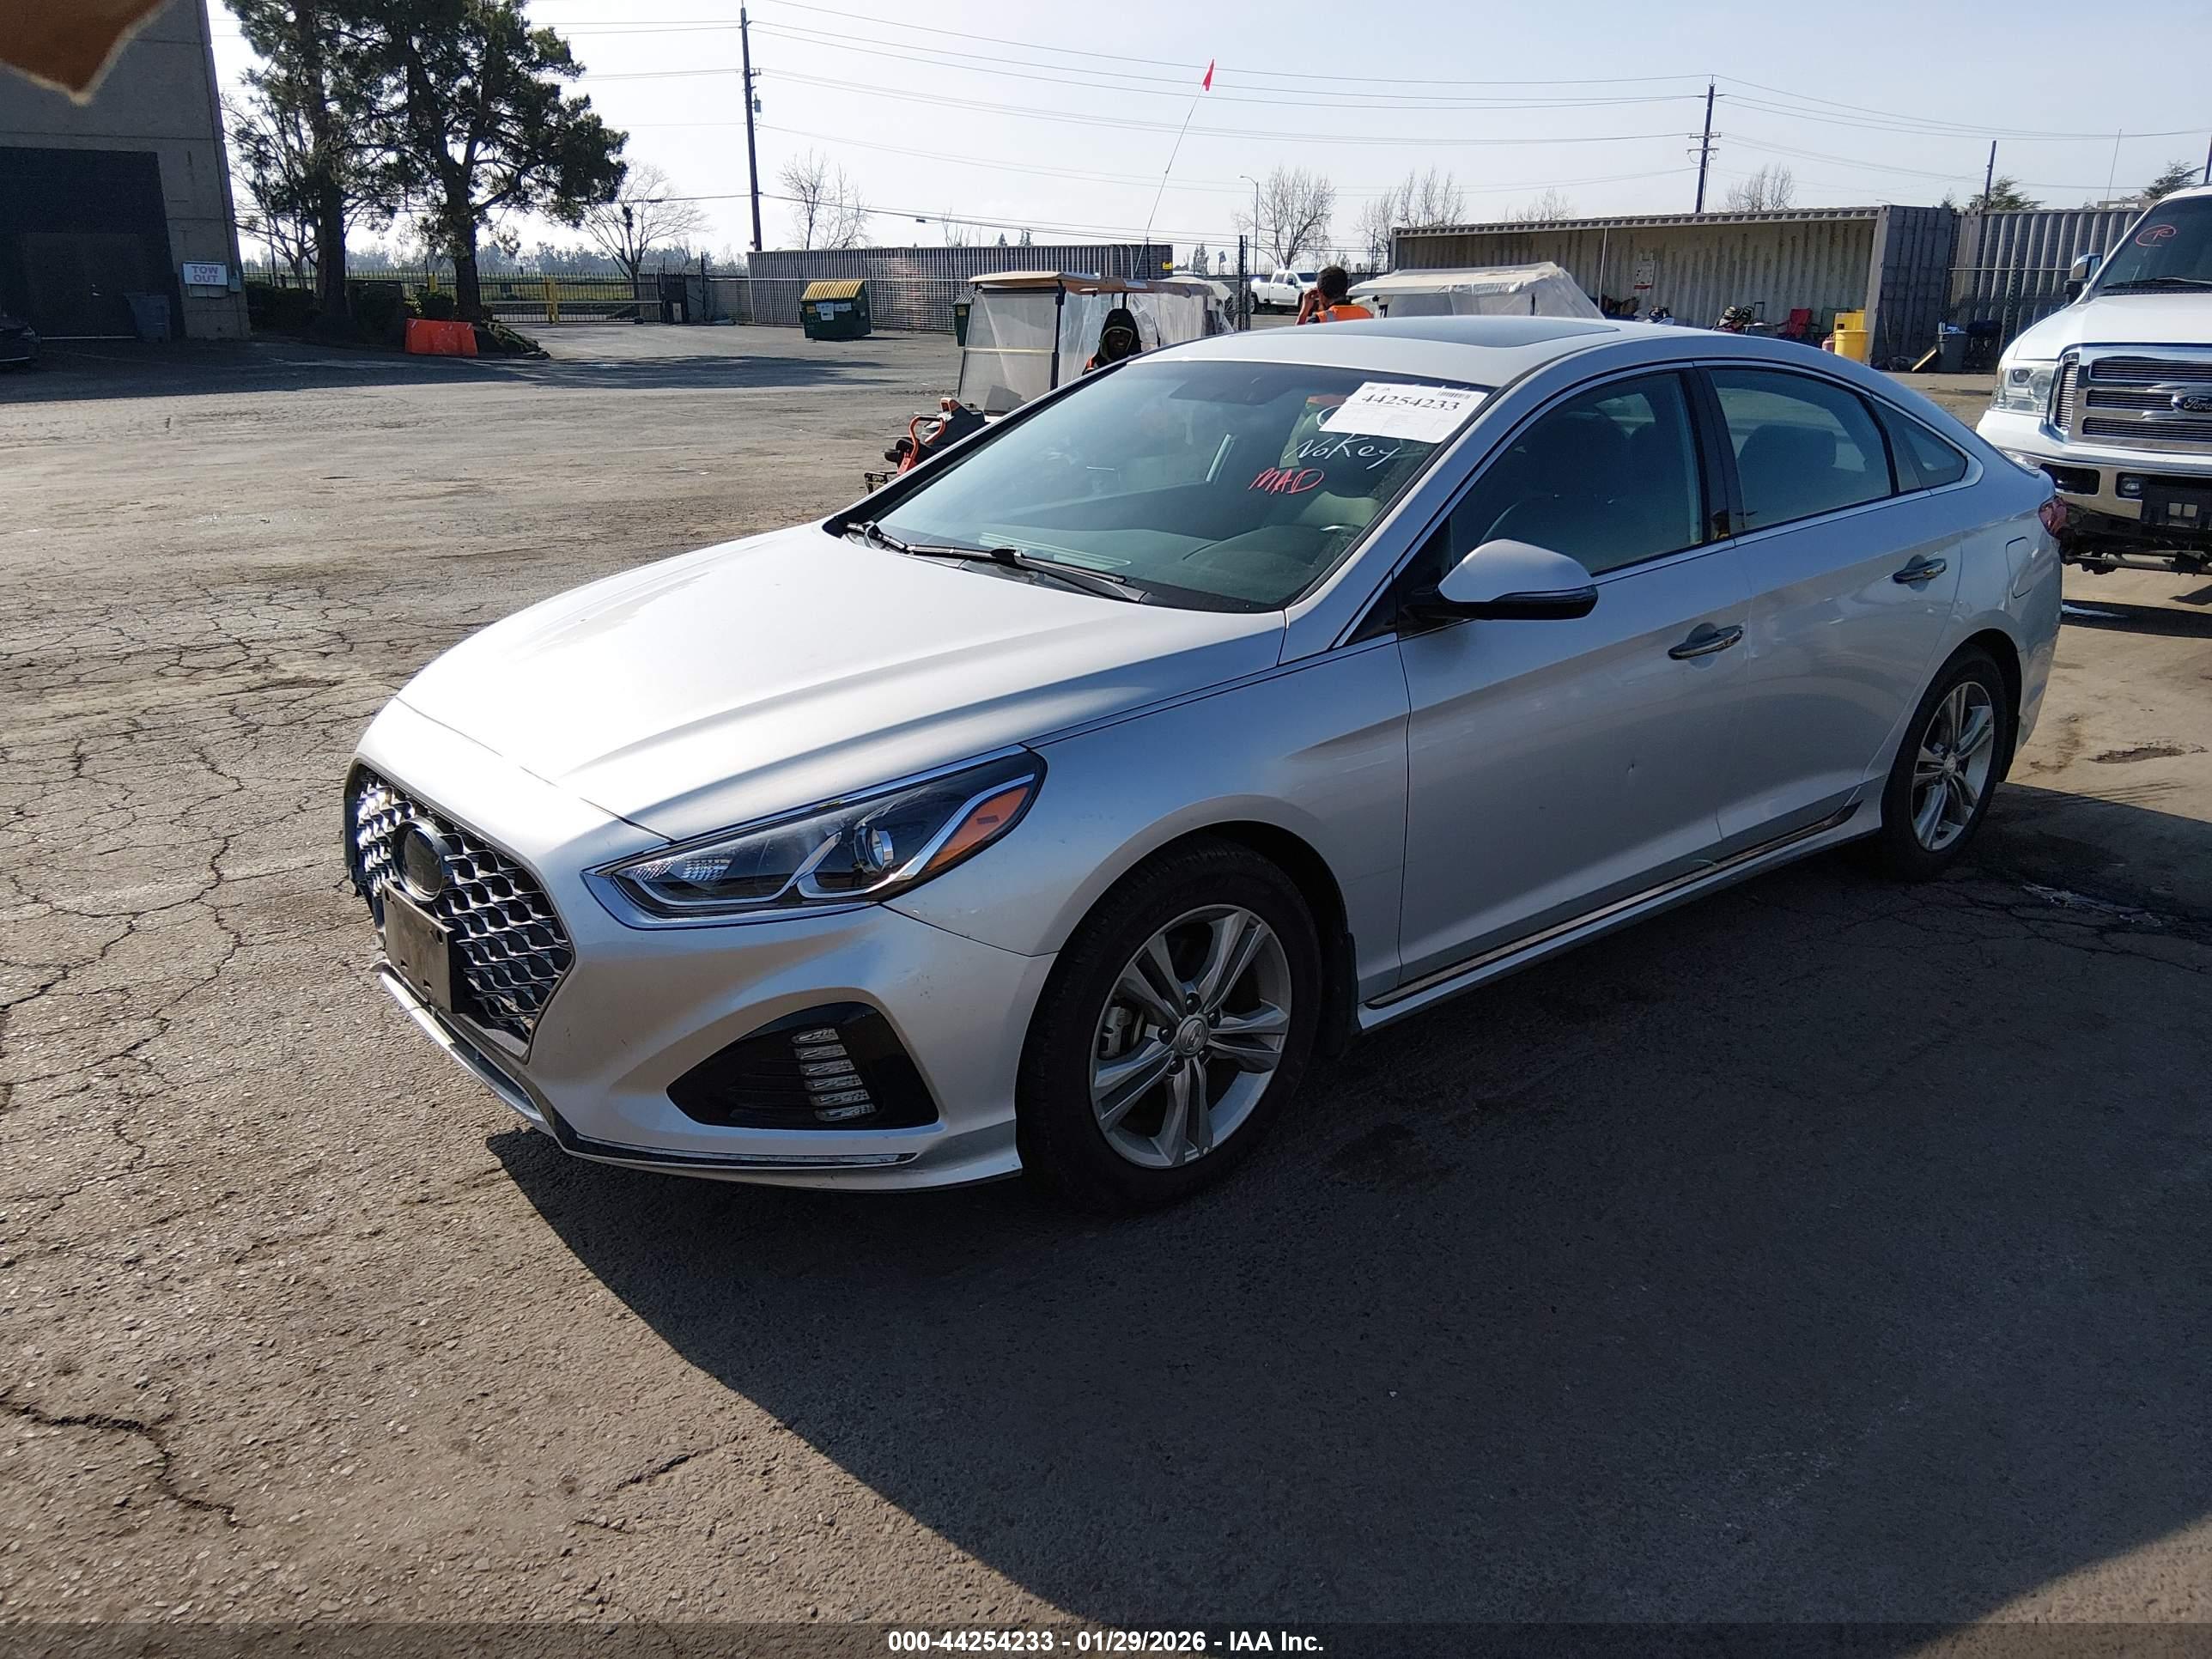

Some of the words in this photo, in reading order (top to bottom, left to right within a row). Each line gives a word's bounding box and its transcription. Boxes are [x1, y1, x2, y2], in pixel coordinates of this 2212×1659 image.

[191, 265, 218, 275] TOW
[193, 274, 218, 283] OUT
[1361, 393, 1461, 411] 44254233
[1248, 466, 1325, 495] MAD
